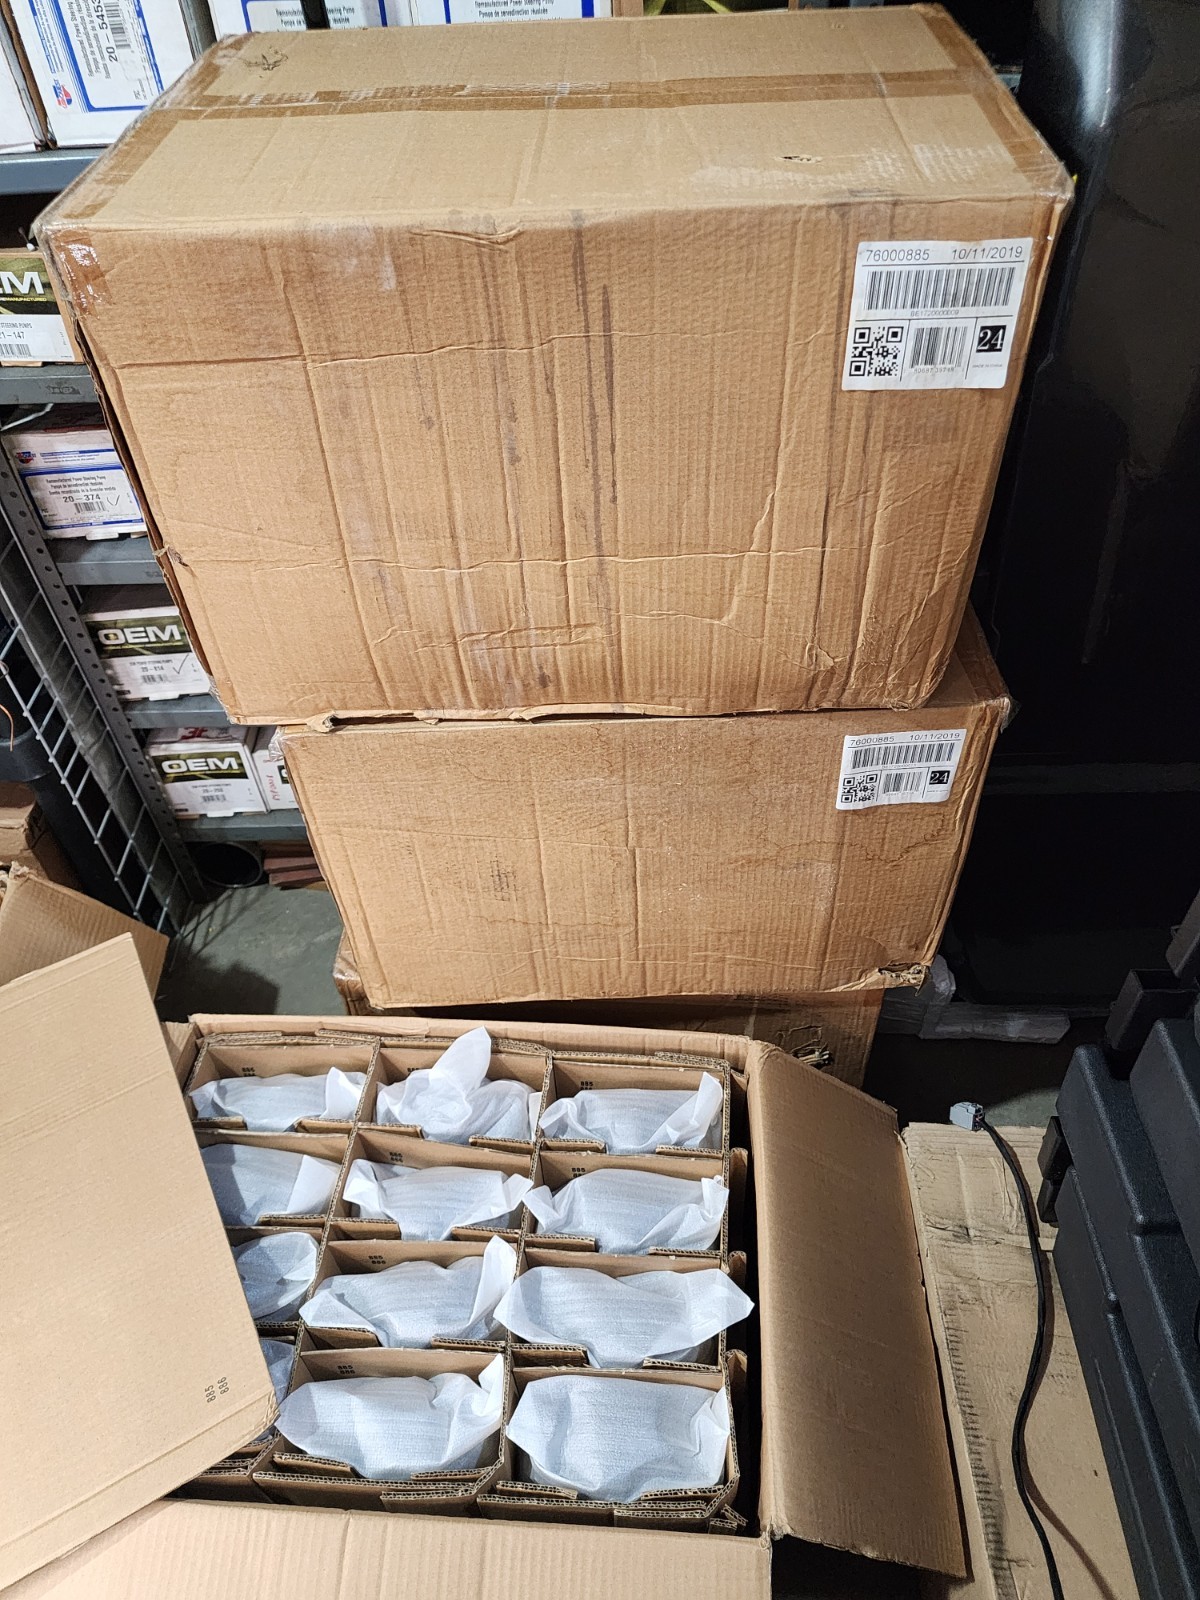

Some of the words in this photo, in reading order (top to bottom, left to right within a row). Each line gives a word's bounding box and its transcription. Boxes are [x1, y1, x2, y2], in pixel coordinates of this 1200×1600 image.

[67, 2, 77, 22] Steering
[106, 46, 118, 62] 20
[865, 248, 930, 262] 76000885
[951, 246, 1023, 260] 10/11/2019
[13, 331, 25, 339] 147
[978, 327, 1004, 350] 24
[98, 624, 181, 645] OEM
[850, 736, 895, 745] 76000885
[910, 732, 961, 741] 10/11/2019
[162, 757, 239, 774] OEM
[931, 772, 949, 784] 24
[204, 1384, 216, 1403] 885
[217, 1376, 230, 1395] 886
